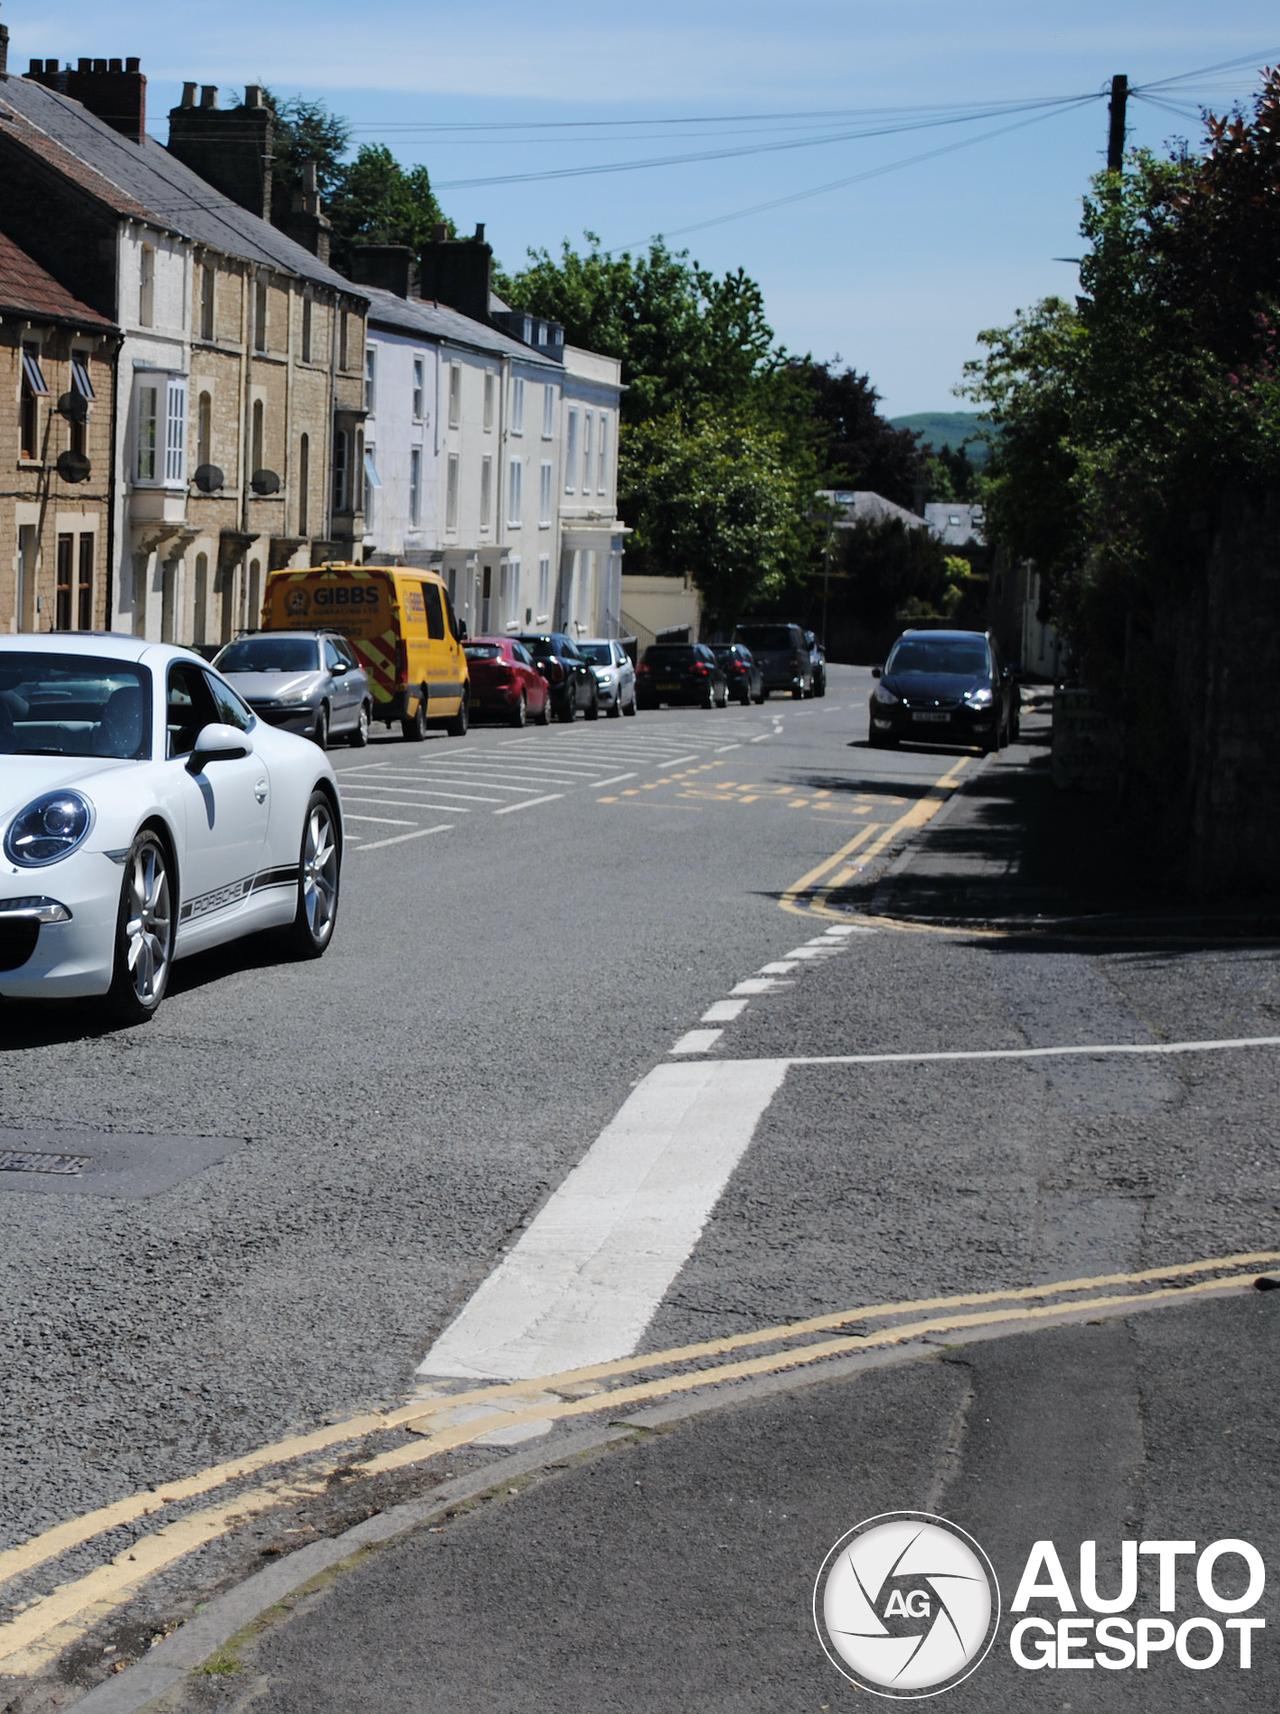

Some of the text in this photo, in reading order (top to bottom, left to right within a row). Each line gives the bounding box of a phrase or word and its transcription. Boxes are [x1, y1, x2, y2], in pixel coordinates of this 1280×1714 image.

[313, 586, 379, 605] GIBBS
[313, 607, 361, 616] SURFACING
[363, 606, 379, 615] LTD
[193, 883, 243, 915] PORSCHE
